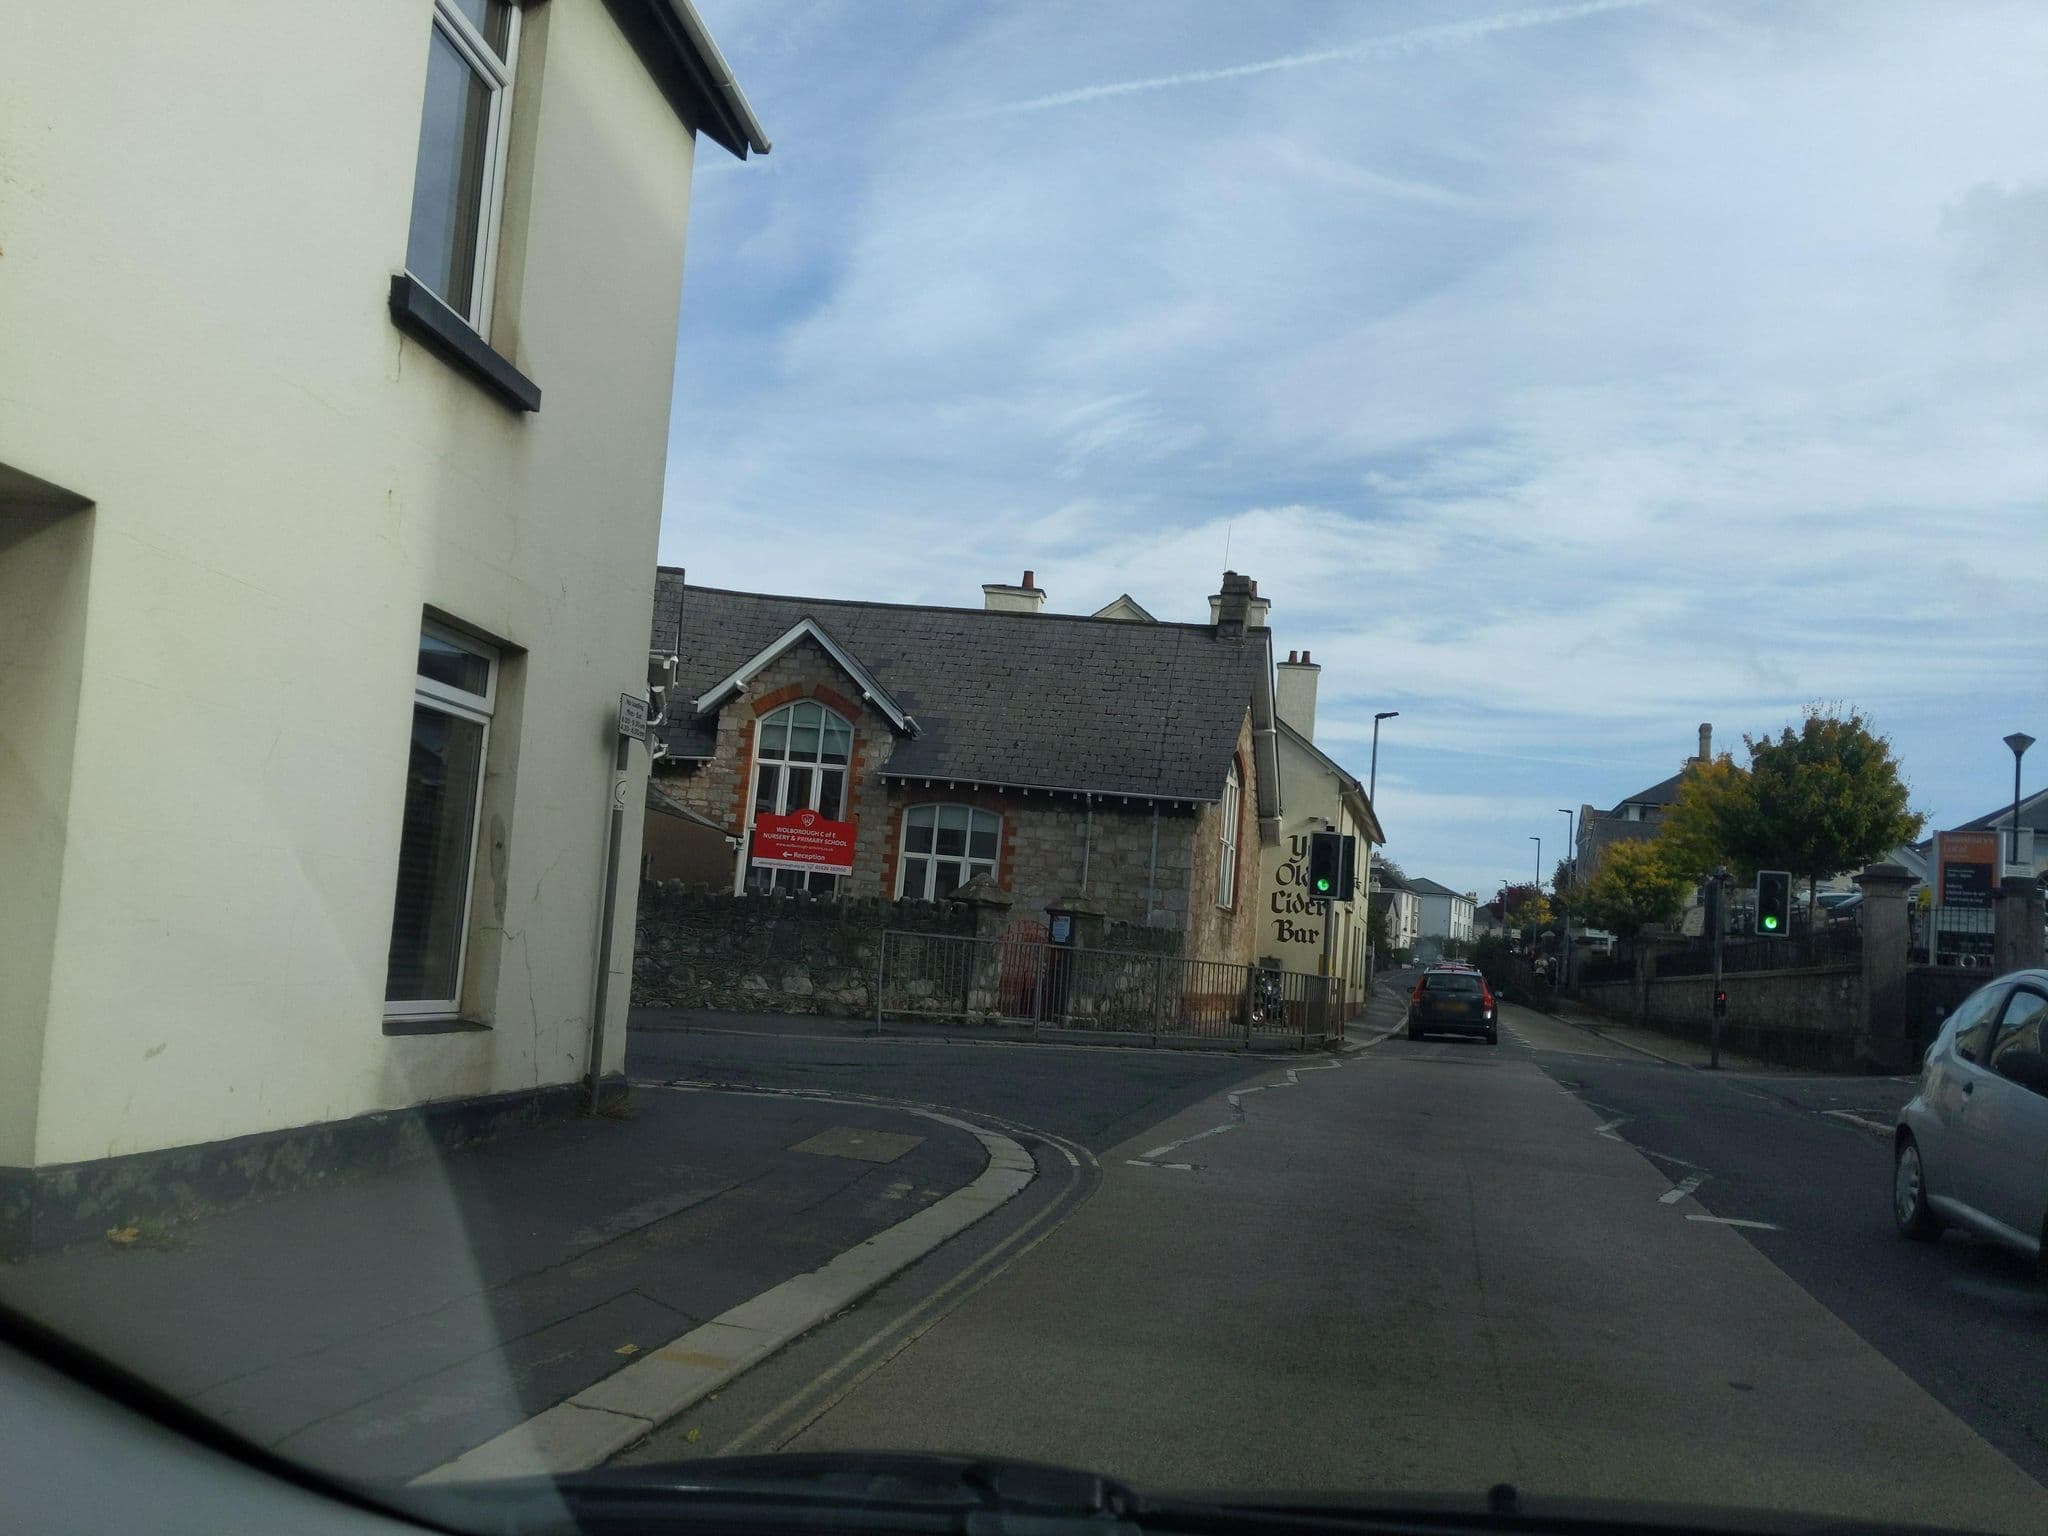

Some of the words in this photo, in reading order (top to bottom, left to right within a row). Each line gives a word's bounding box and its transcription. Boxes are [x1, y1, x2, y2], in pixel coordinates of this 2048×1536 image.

[776, 826, 820, 837] WOLBOROUGH
[762, 832, 790, 841] NURSERY
[797, 836, 824, 845] PRIMARY
[824, 838, 848, 847] SCHOOL
[793, 851, 826, 861] Reception
[1271, 890, 1325, 916] Cider
[1271, 919, 1319, 944] Bar
